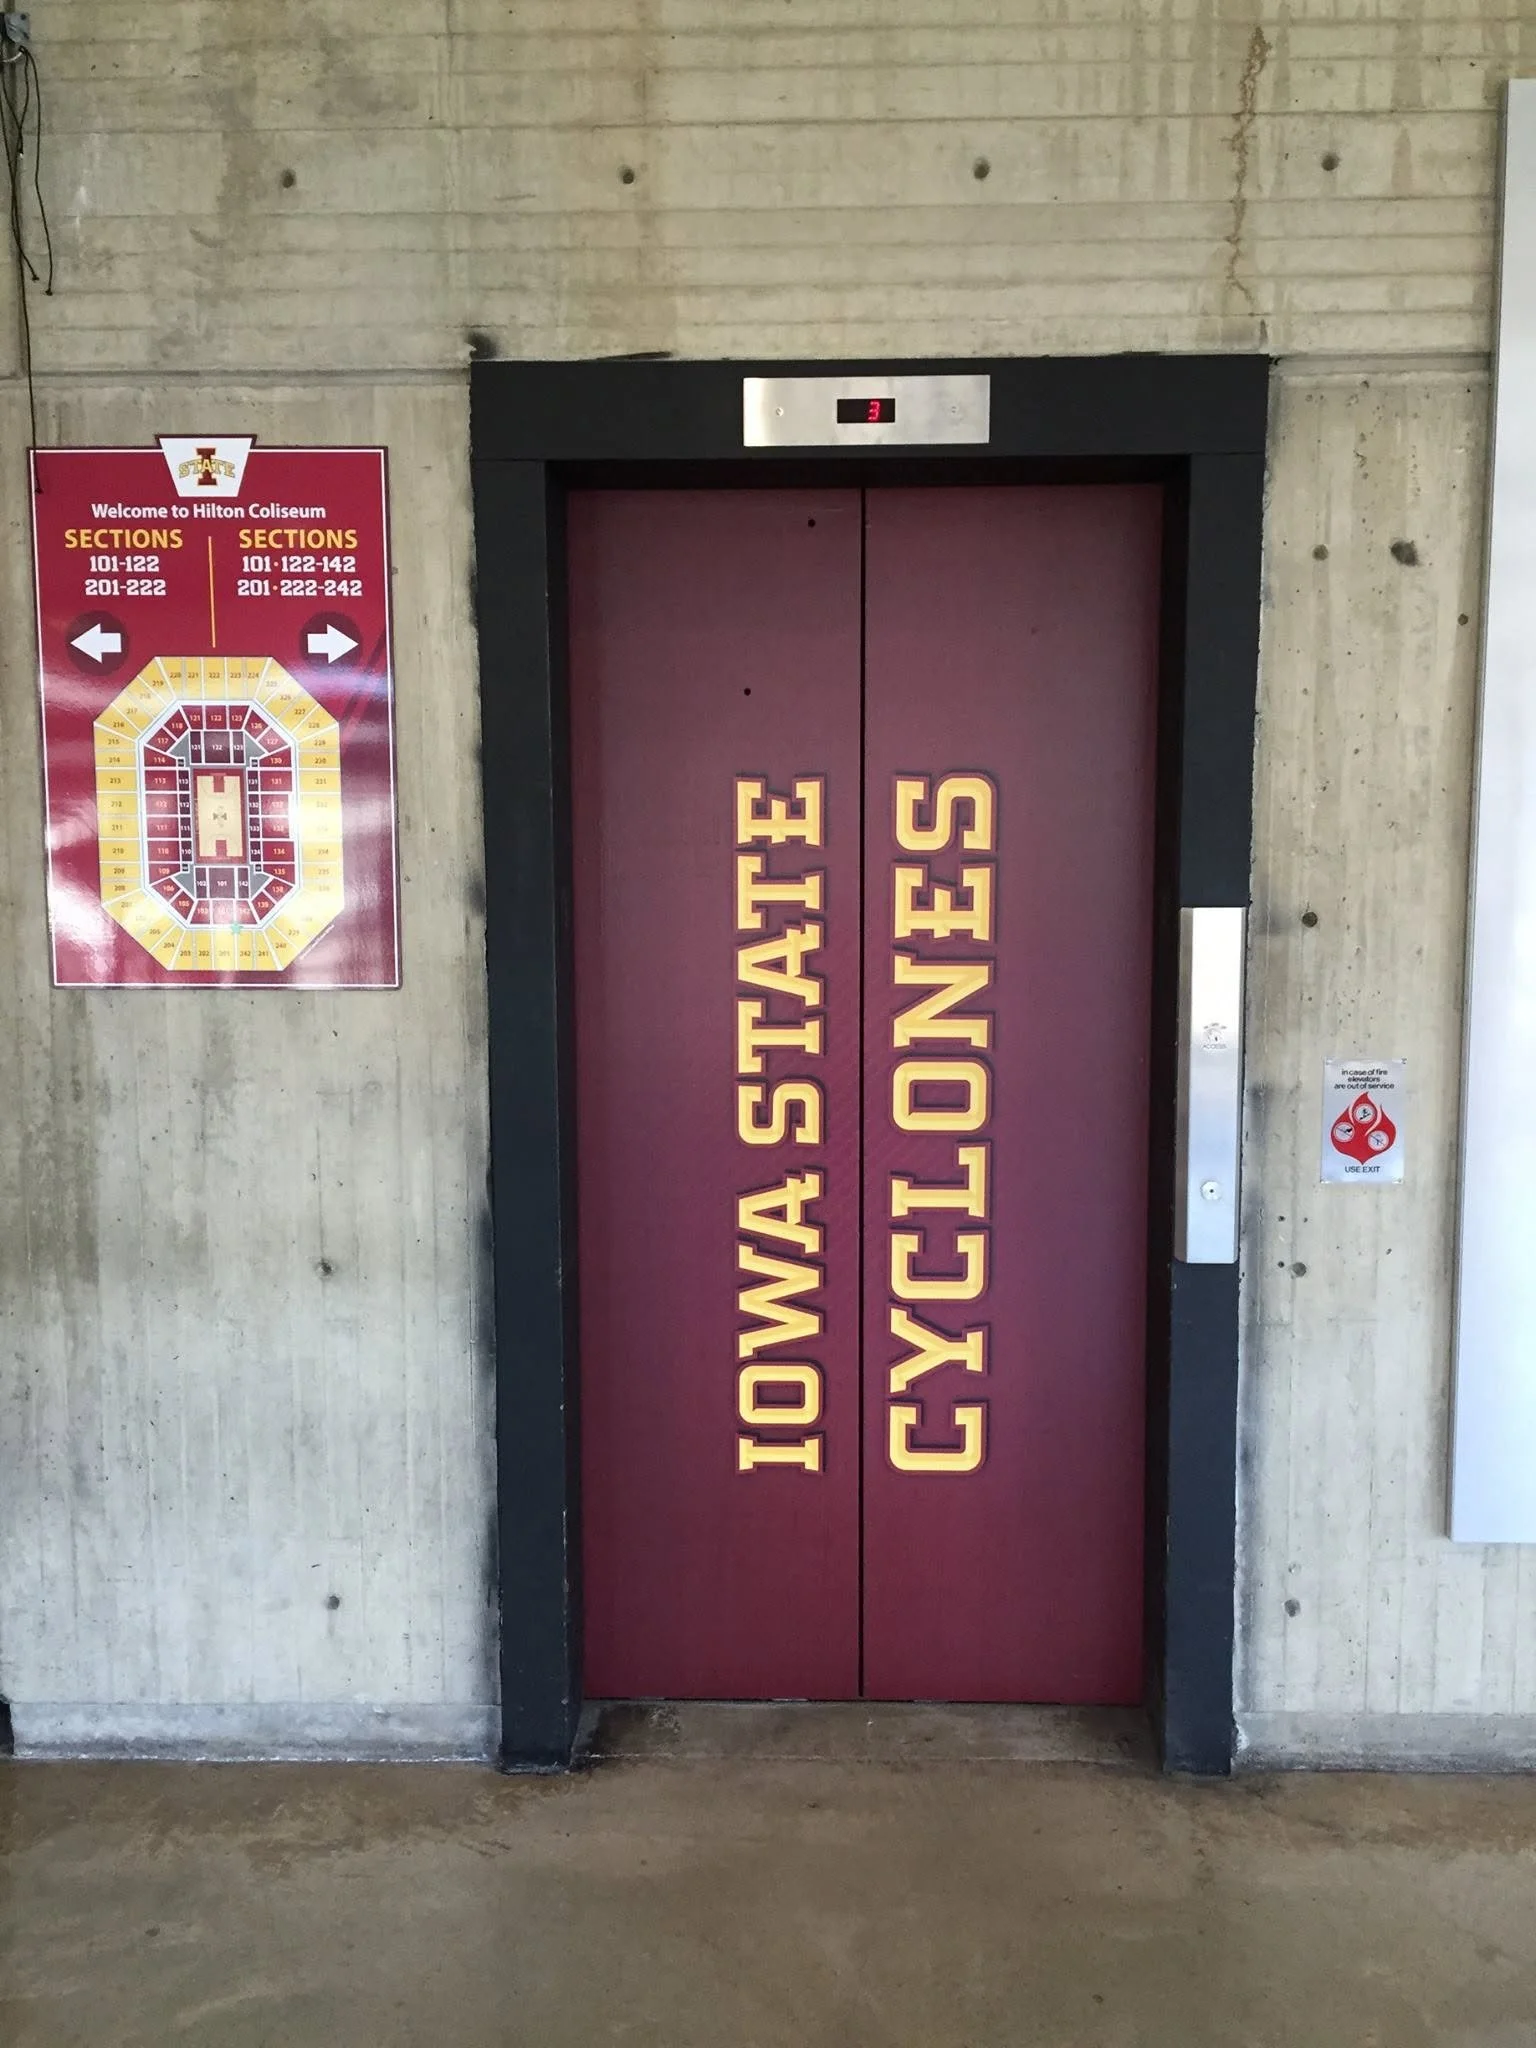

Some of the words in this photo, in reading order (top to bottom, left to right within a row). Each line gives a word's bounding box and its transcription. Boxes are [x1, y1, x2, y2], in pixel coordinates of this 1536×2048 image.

[868, 401, 880, 420] 3
[178, 458, 236, 479] STATE
[91, 503, 168, 519] Welcome
[171, 504, 189, 519] to
[192, 503, 245, 519] Hilton
[248, 503, 326, 519] Coliseum
[64, 528, 184, 550] SECTIONS
[238, 528, 358, 550] SECTIONS
[89, 555, 160, 573] 101-122
[84, 578, 166, 596] 201-222
[736, 776, 822, 1146] STATE
[888, 773, 995, 1474] CYCLONES
[736, 1171, 822, 1472] IOWA
